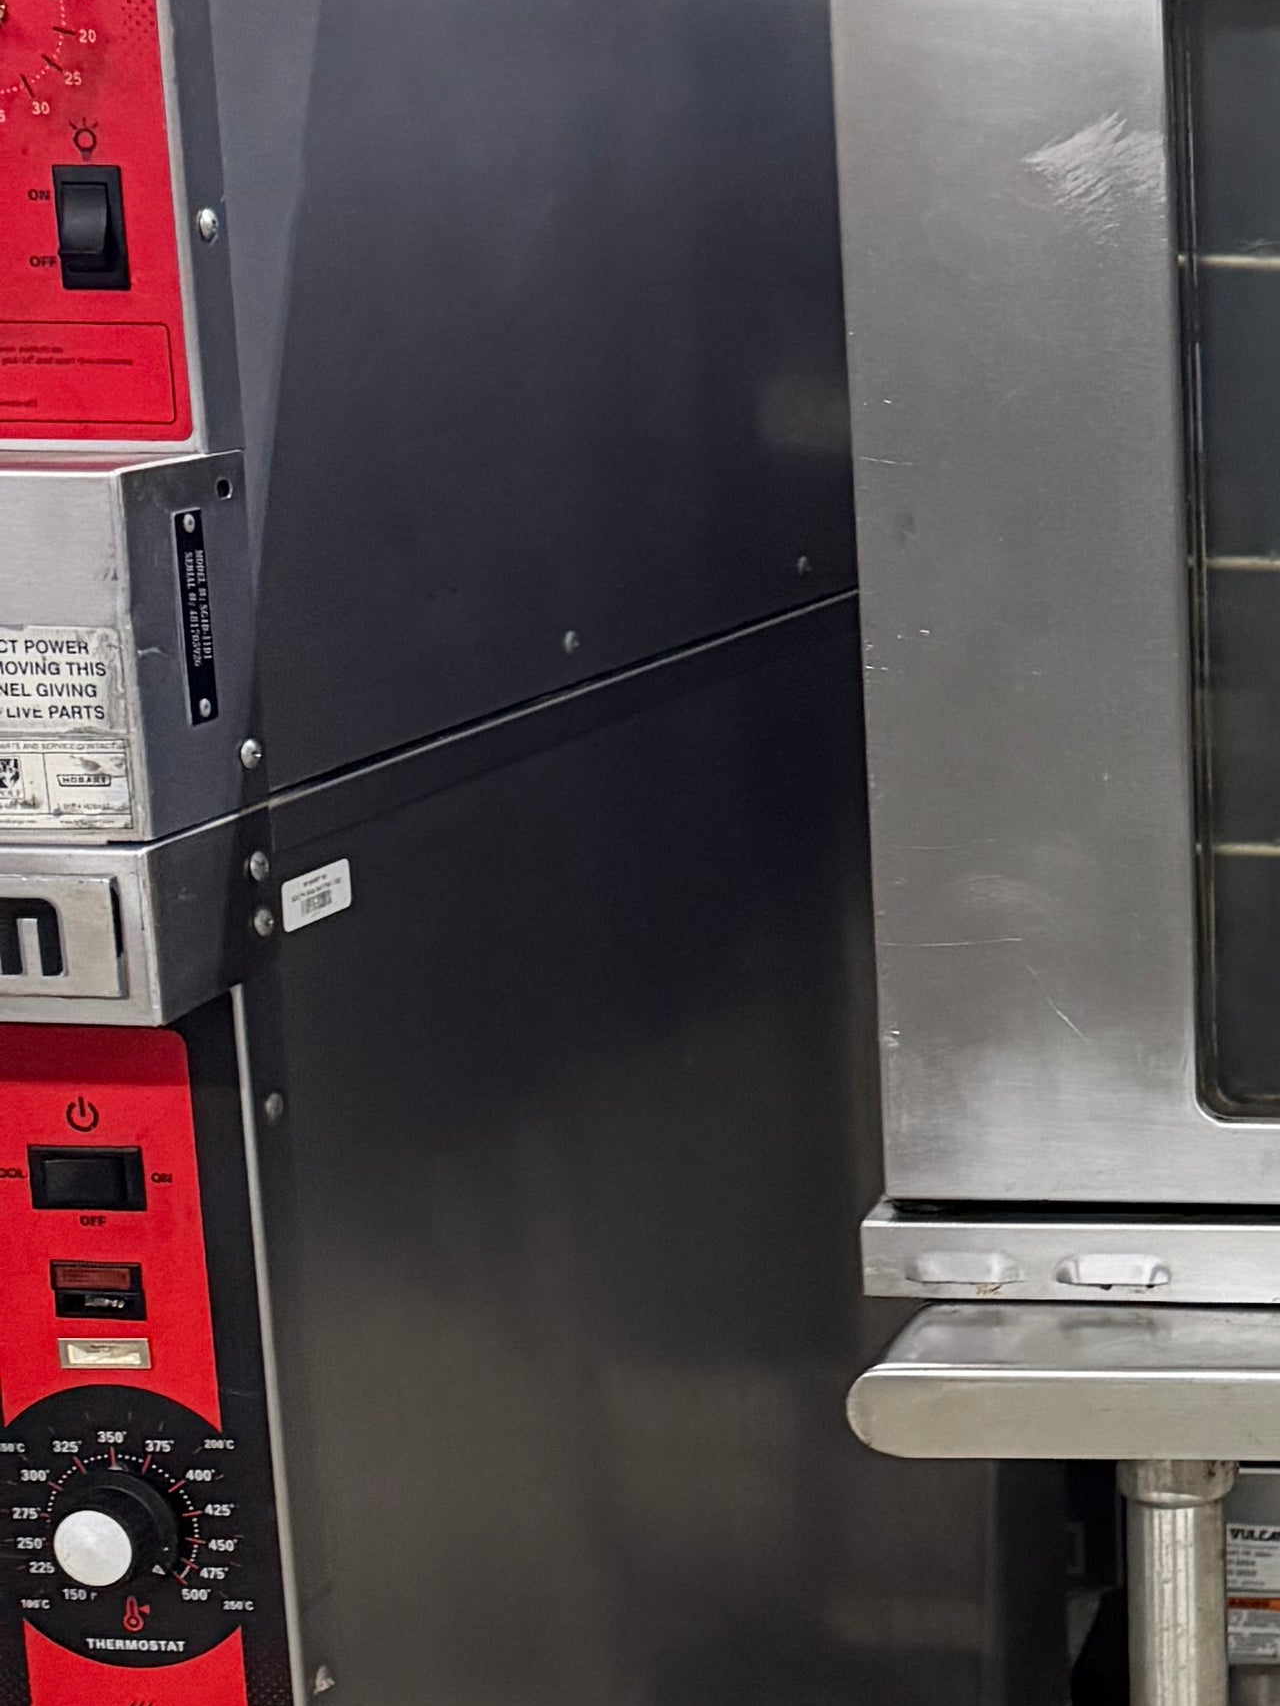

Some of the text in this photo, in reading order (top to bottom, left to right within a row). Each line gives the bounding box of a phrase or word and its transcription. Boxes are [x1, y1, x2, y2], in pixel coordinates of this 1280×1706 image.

[79, 30, 96, 43] 20
[64, 72, 82, 85] 25
[32, 102, 50, 115] 30
[28, 189, 50, 201] ON
[29, 255, 56, 268] OFF
[25, 640, 89, 654] POWER
[66, 662, 106, 676] THIS
[36, 683, 97, 697] GIVING
[49, 706, 105, 719] PARTS
[85, 1638, 186, 1652] THERMOSTAT
